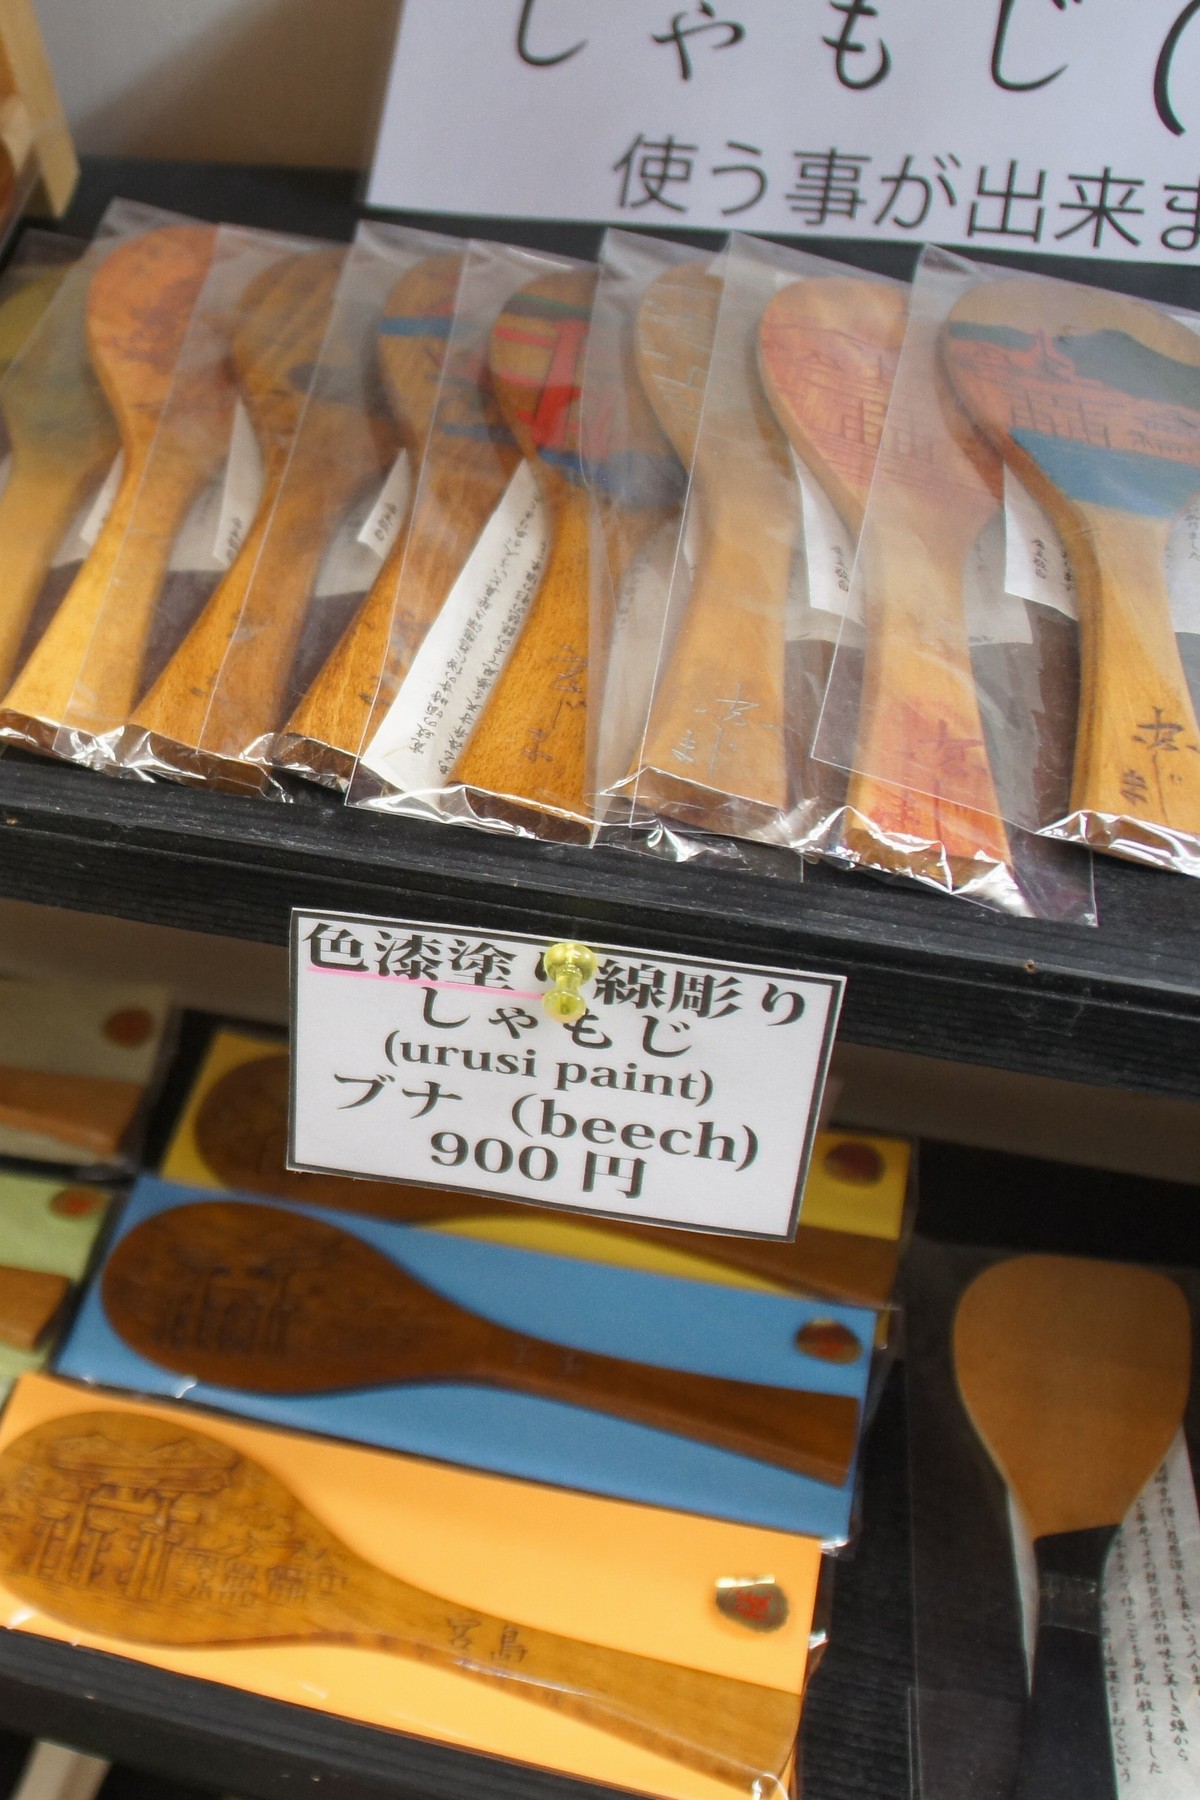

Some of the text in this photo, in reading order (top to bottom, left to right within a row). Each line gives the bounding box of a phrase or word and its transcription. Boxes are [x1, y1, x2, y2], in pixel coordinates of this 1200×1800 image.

[421, 986, 693, 1058] しゃもじ
[384, 1029, 714, 1108] (urusi paint)
[333, 1072, 760, 1173] ブナ (beech)
